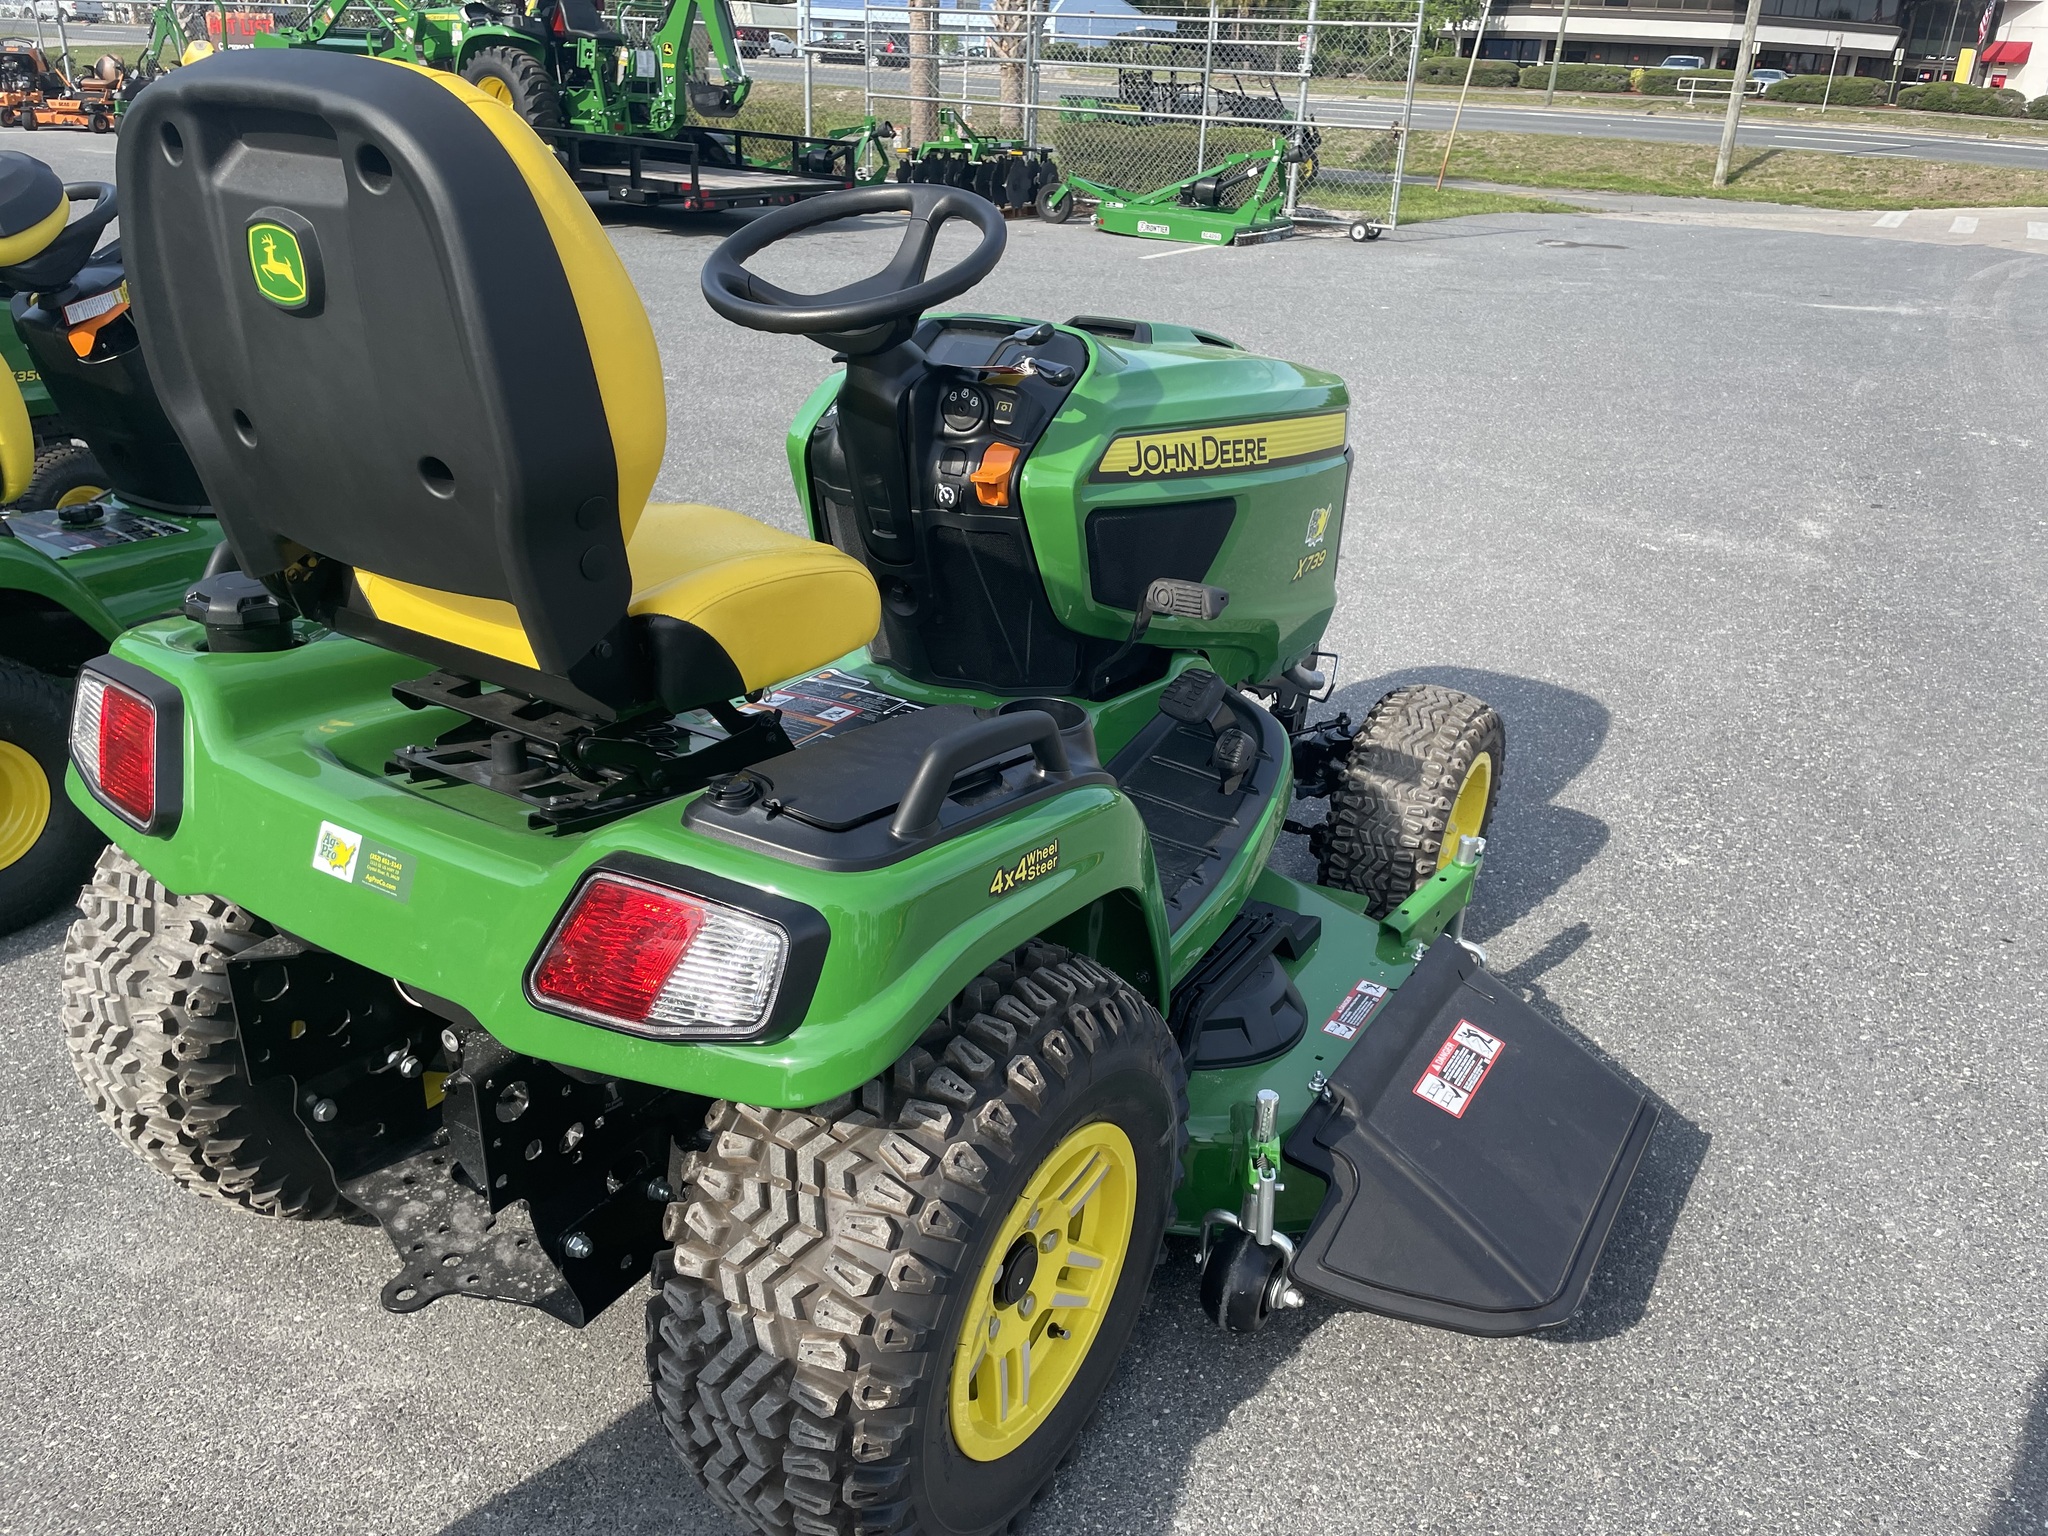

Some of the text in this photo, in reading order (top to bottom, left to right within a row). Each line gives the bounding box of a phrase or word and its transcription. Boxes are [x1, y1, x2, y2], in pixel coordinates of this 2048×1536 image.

[209, 19, 236, 35] HT
[1129, 436, 1268, 472] JOHN DEERE
[1292, 549, 1328, 582] X739
[319, 843, 337, 860] Pro
[1026, 839, 1058, 867] Wheel
[990, 857, 1027, 893] 4x4
[1027, 855, 1058, 881] Steer
[1437, 1042, 1456, 1066] DANGER
